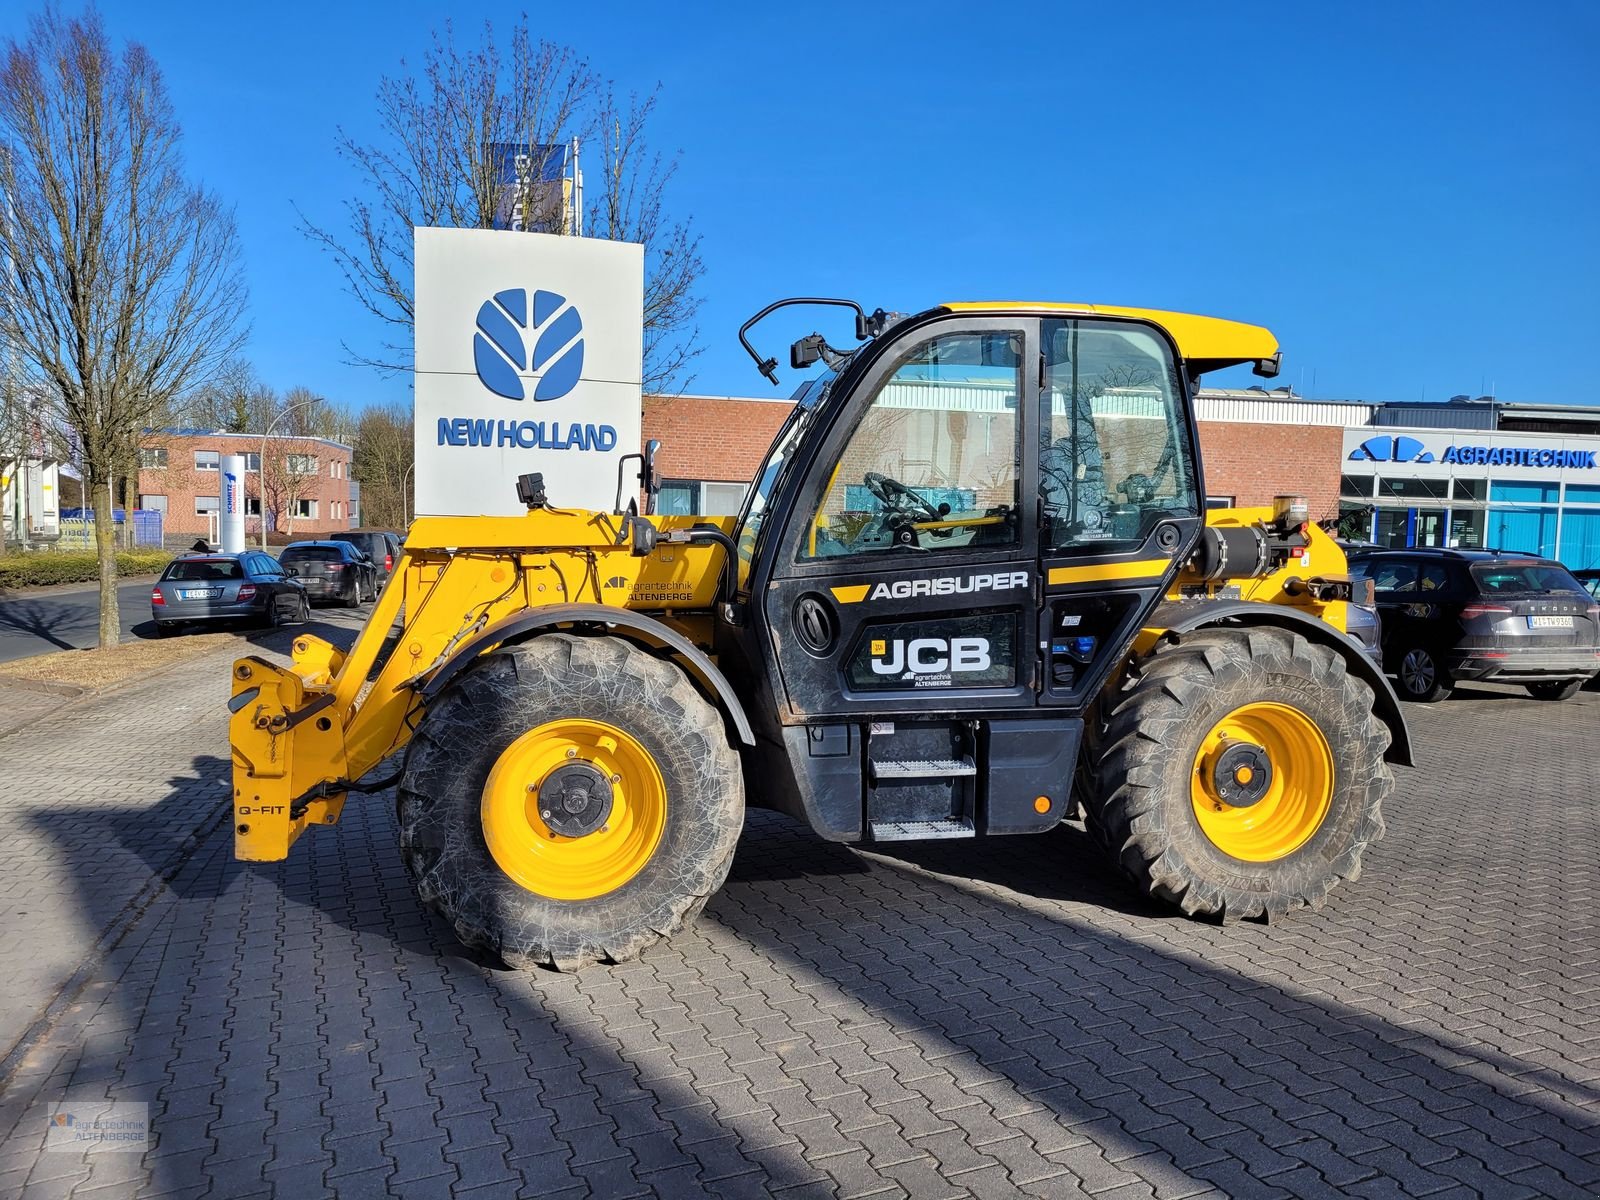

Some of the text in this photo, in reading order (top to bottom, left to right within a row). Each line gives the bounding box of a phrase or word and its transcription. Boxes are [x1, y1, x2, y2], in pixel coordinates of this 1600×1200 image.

[437, 417, 618, 452] NEW HOLLAND
[1442, 445, 1598, 469] AGRARTECHNIK
[627, 580, 693, 593] agrartechnik
[627, 592, 693, 602] ALTENBERGE
[870, 571, 1029, 601] AGRISUPER
[871, 637, 991, 675] JCB
[238, 806, 286, 815] Q-FIT
